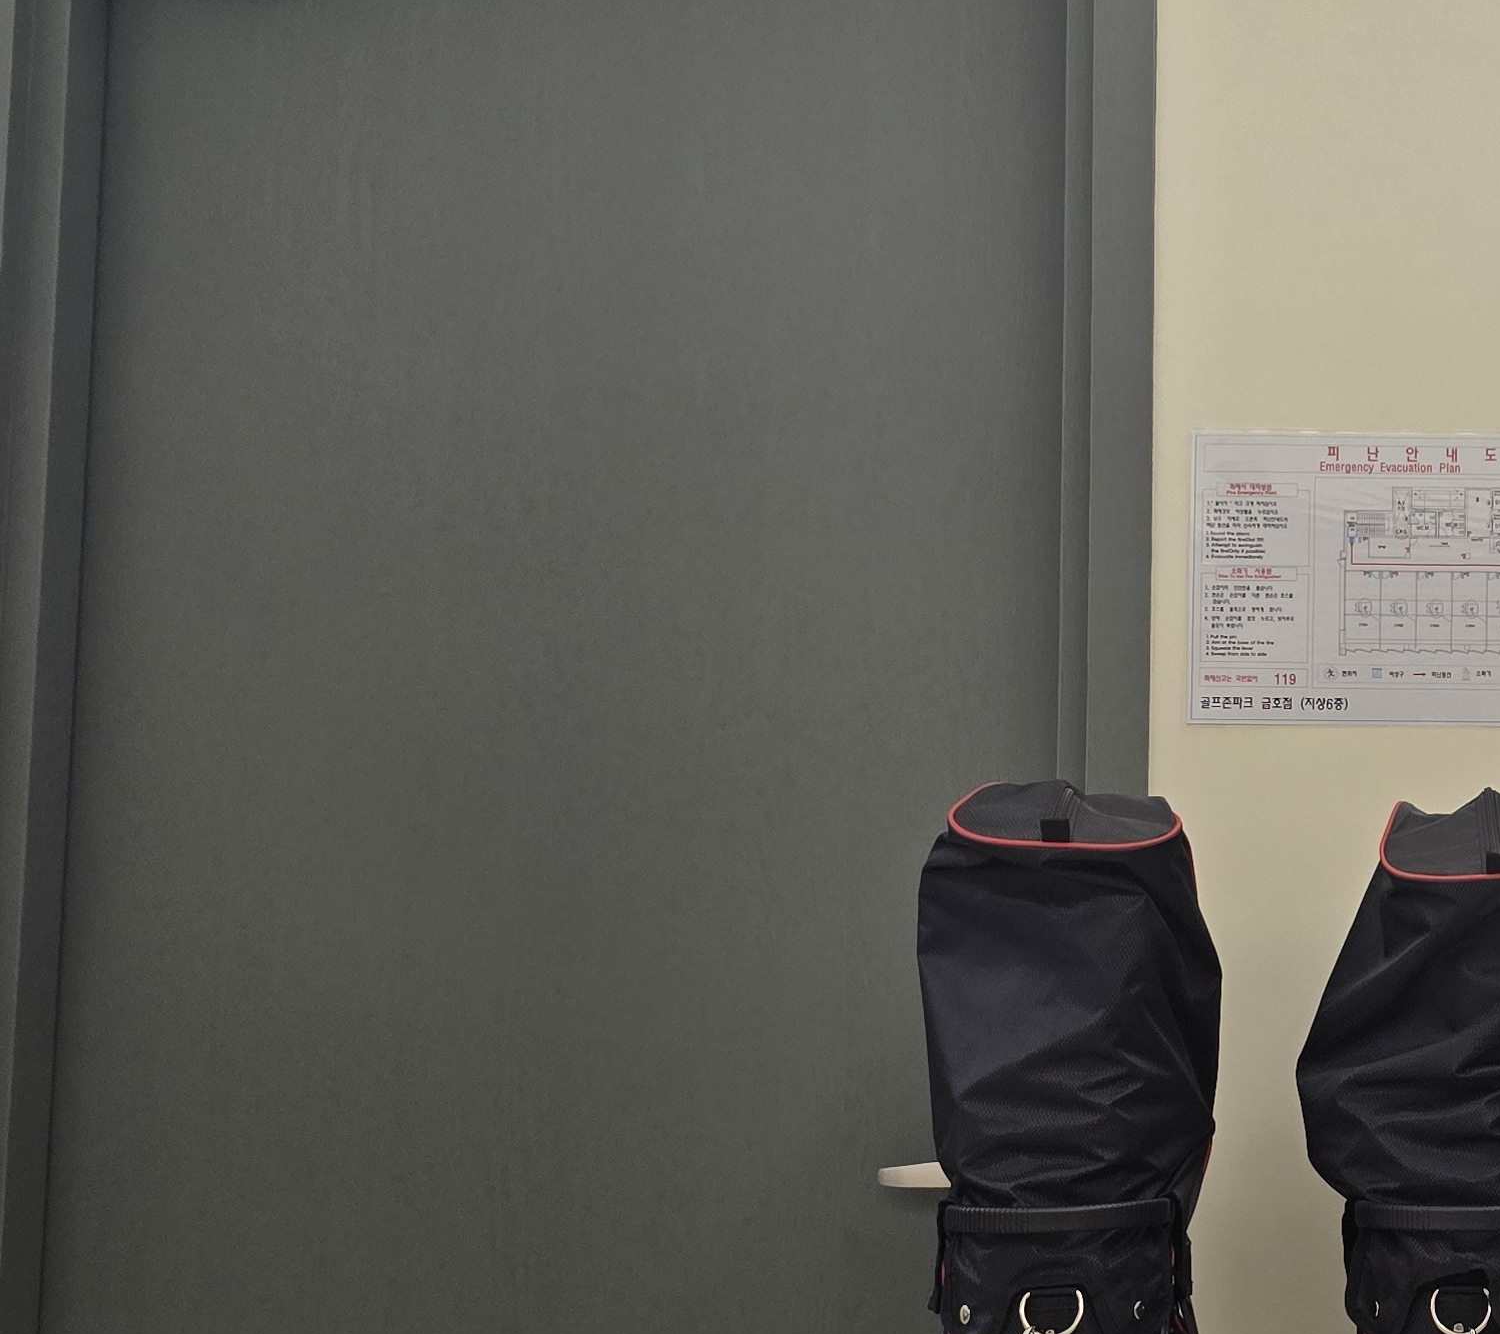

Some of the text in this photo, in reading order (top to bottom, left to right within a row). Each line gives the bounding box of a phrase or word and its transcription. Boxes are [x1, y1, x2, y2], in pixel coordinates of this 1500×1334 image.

[1319, 461, 1461, 475] Emergency Evacuation Plan
[1275, 673, 1296, 685] 119
[1200, 696, 1253, 709] 골프존파크
[1261, 697, 1293, 709] 금호점
